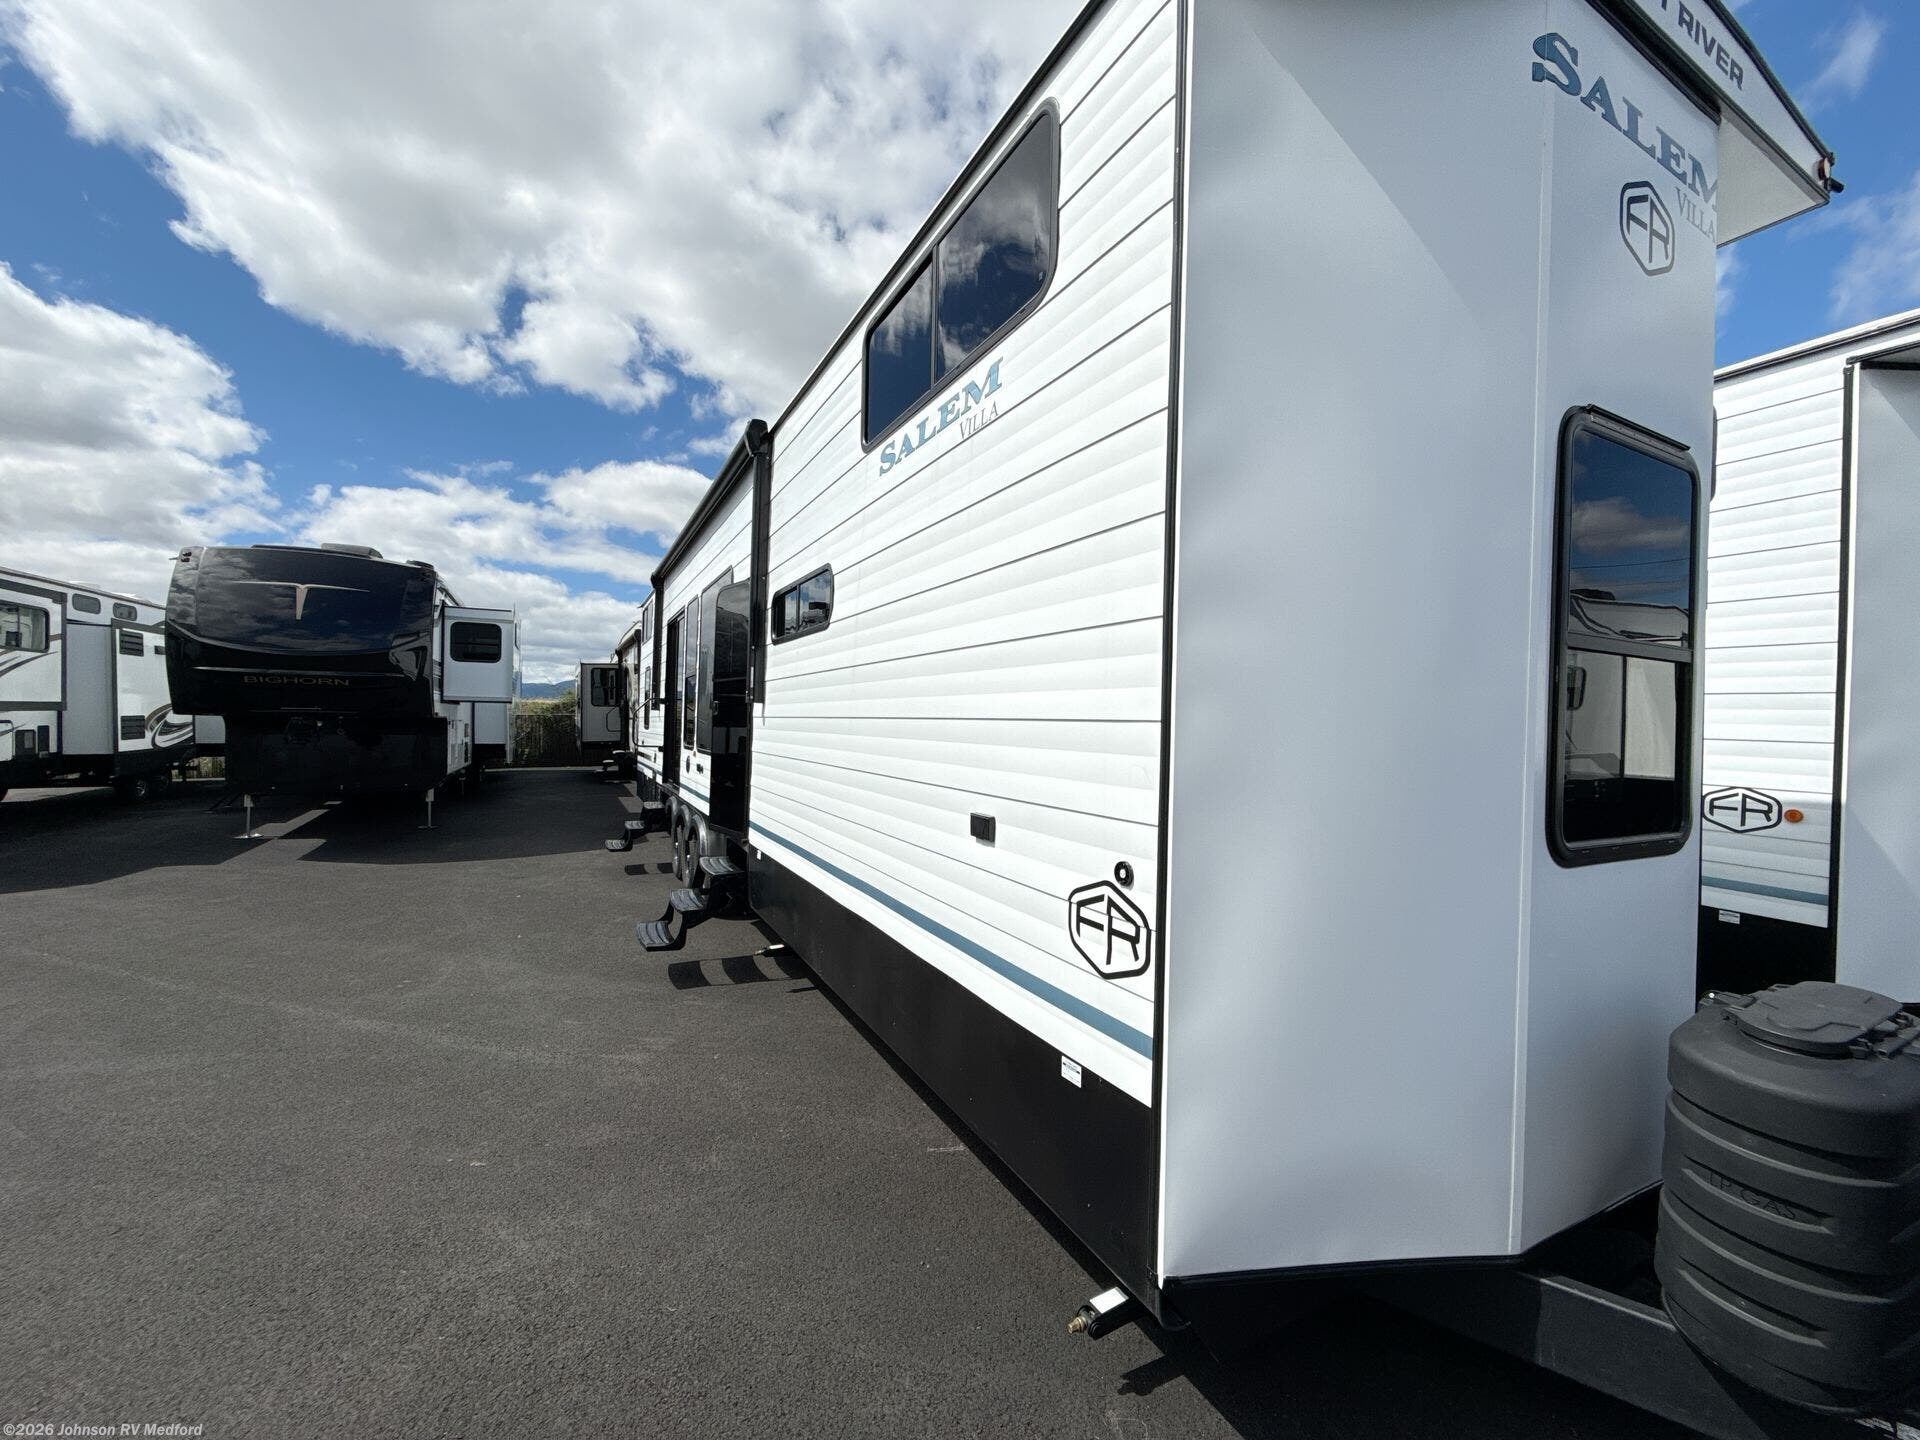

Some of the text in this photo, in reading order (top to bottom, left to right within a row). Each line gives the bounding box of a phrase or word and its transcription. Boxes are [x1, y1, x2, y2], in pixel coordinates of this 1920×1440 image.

[1678, 1, 1744, 91] RIVER
[1532, 32, 1718, 211] SALEM
[1675, 186, 1717, 243] VILLA
[879, 356, 1004, 477] SALEM
[959, 400, 999, 439] VILLA
[243, 675, 349, 687] BIGHORN
[1741, 1187, 1796, 1220] GAS
